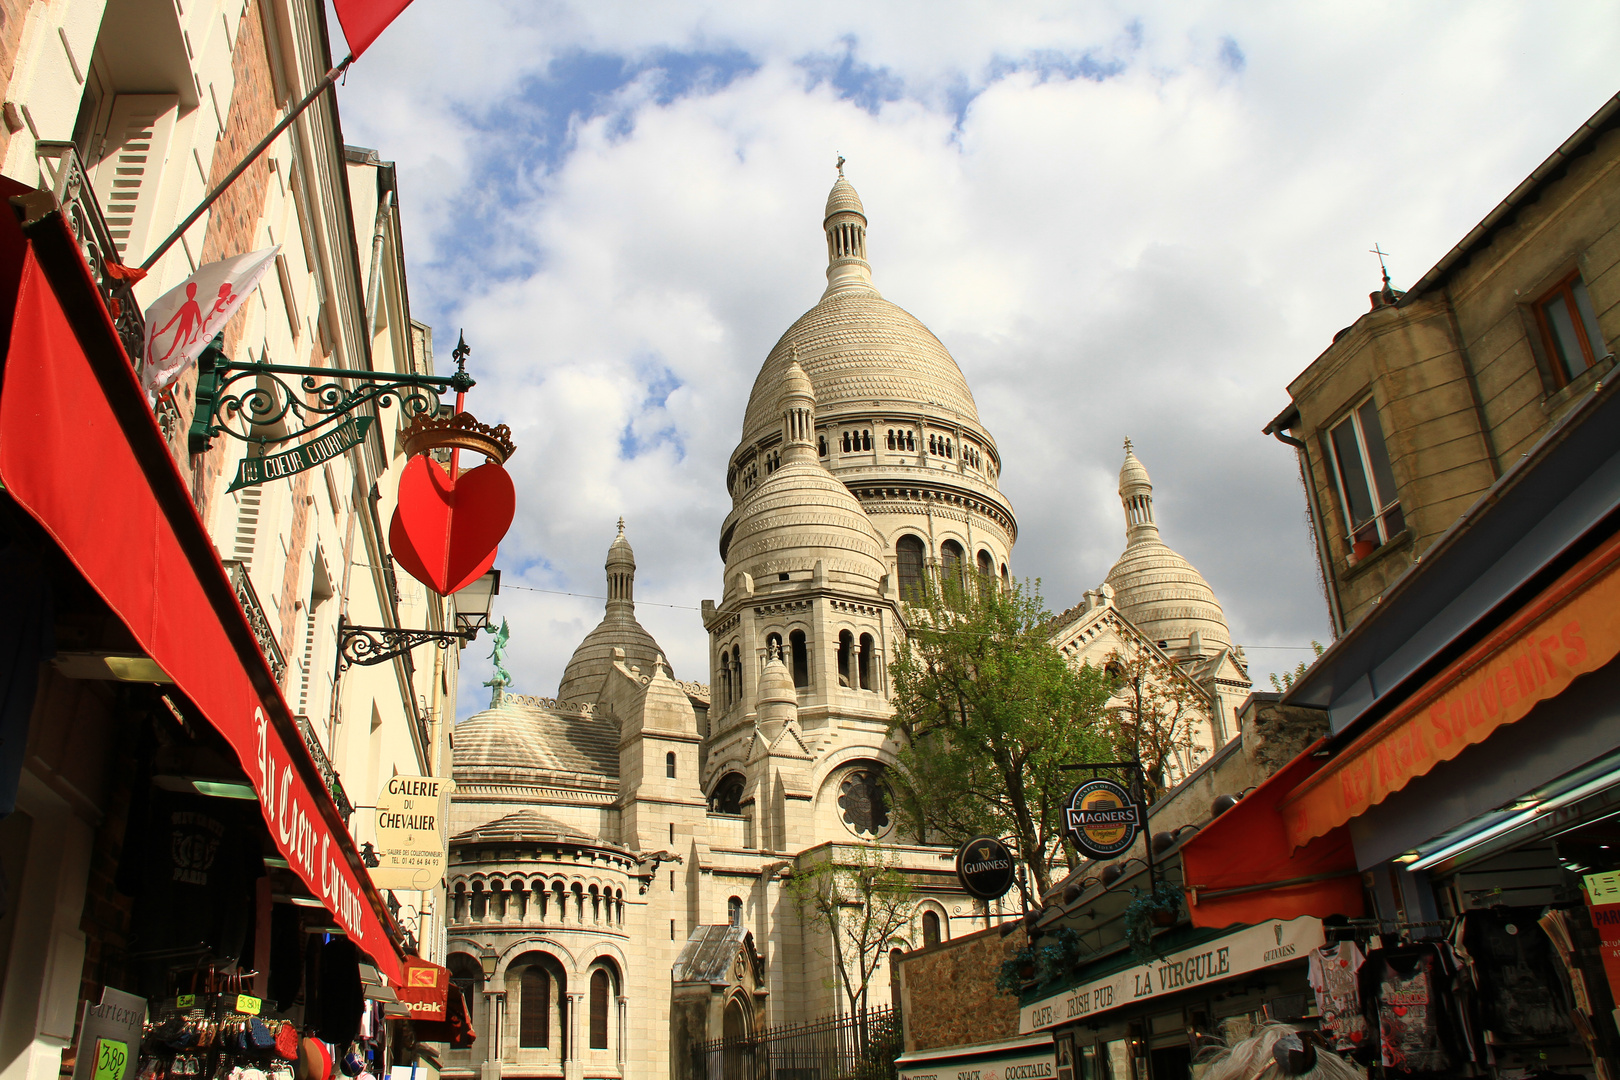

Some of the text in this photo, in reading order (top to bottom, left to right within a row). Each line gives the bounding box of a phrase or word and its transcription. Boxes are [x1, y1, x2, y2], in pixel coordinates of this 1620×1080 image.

[241, 461, 258, 484] AU
[264, 451, 305, 479] COEUR
[1429, 619, 1588, 749] Souvenirs
[255, 705, 276, 823] Au
[388, 779, 439, 797] GALERIE
[404, 800, 414, 810] DU
[379, 812, 435, 831] CHEVALIER
[1072, 810, 1135, 824] MAGNERS
[402, 857, 407, 865] 01
[417, 858, 423, 866] 64
[425, 858, 431, 866] 84
[433, 859, 439, 867] 93
[964, 859, 1009, 875] GUINNESS
[1263, 943, 1296, 963] GUINNESS
[1032, 1005, 1052, 1028] CAFE
[1067, 992, 1090, 1018] IRISH
[1094, 985, 1113, 1010] PUB
[1133, 971, 1153, 998] LA
[1158, 946, 1230, 991] VIRGULE
[400, 1000, 441, 1013] odak
[1005, 1062, 1051, 1080] COCKTAILS
